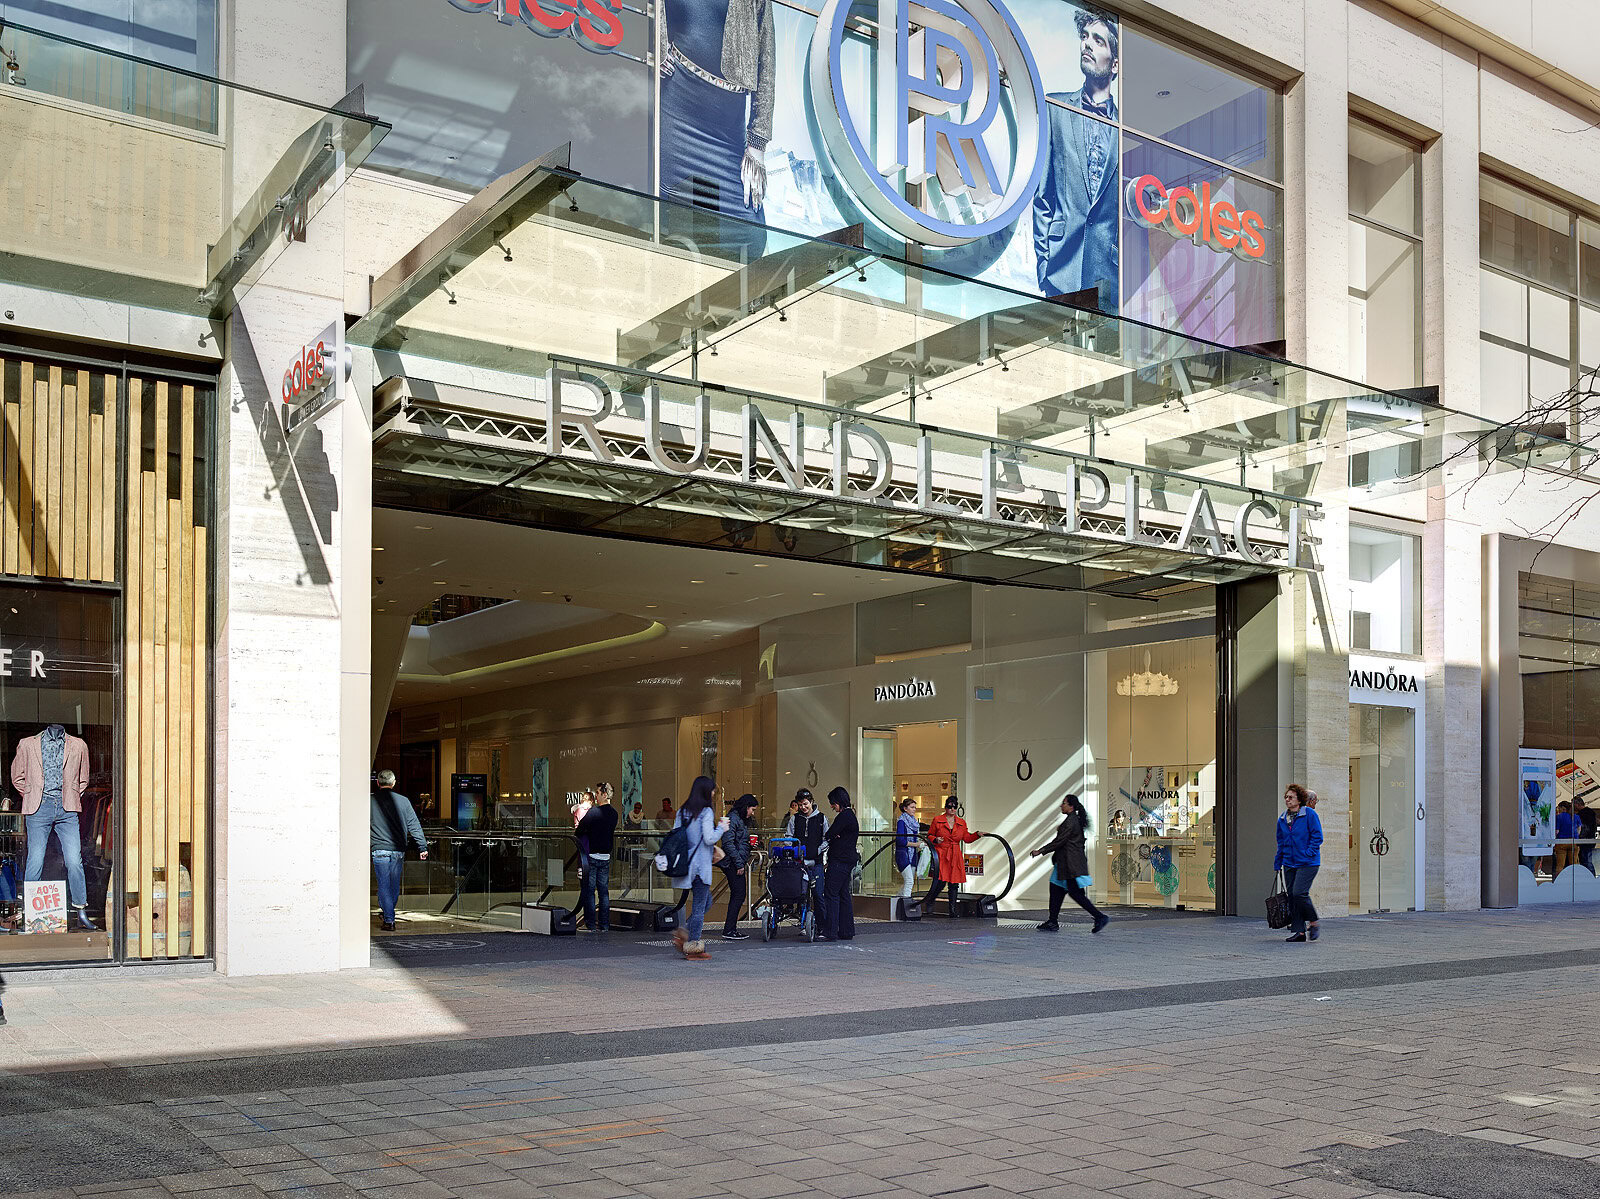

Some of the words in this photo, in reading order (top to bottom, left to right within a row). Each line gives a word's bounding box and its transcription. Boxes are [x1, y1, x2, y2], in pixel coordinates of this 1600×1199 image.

[1128, 174, 1265, 260] coles
[282, 341, 325, 404] coles
[546, 367, 1028, 526] RUNDLE
[1066, 462, 1326, 571] PLACE
[874, 677, 934, 701] PANDORA
[1137, 788, 1179, 799] PANDORA
[37, 884, 58, 895] 40%
[32, 893, 61, 911] OFF
